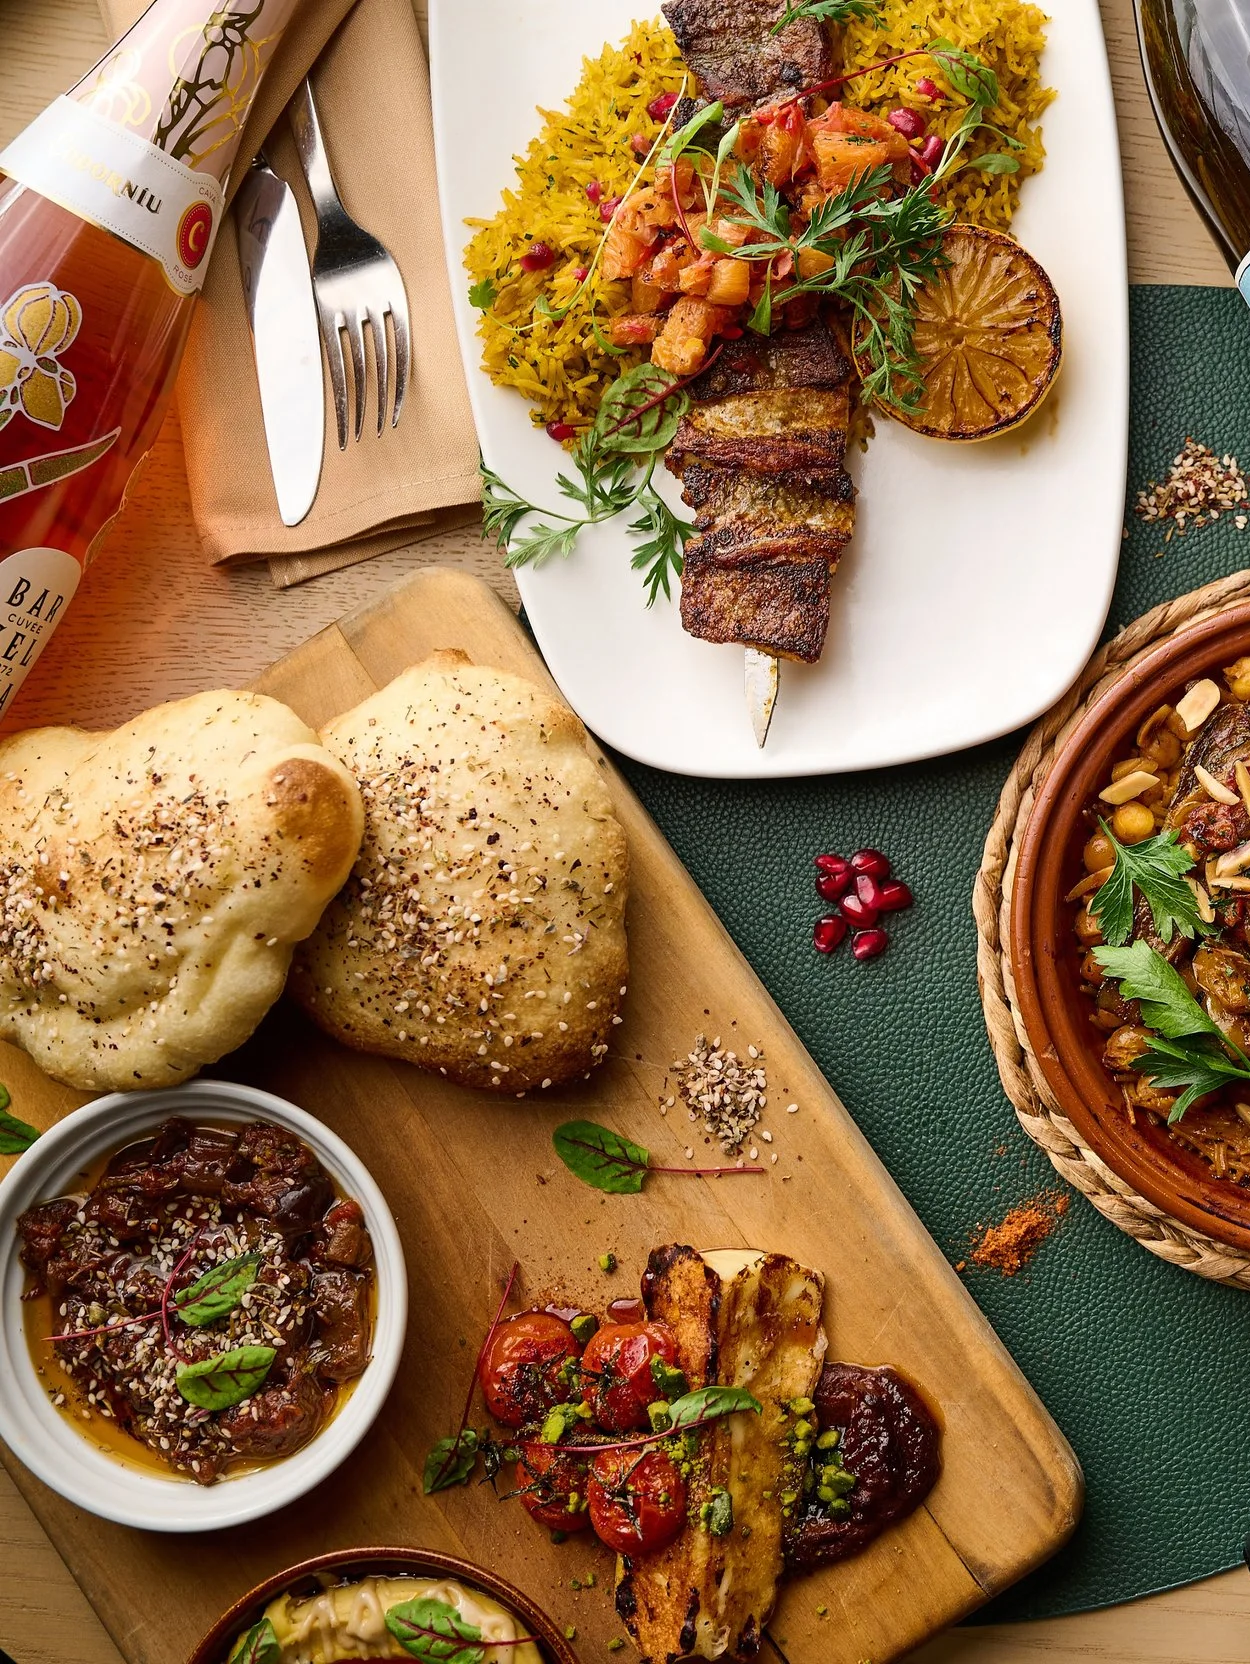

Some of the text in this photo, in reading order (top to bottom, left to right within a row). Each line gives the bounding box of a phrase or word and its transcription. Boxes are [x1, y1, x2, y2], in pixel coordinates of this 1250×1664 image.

[198, 187, 217, 204] CAVA
[188, 220, 205, 252] C
[173, 264, 193, 284] ROSÉ
[5, 576, 64, 624] BAR
[7, 613, 44, 635] CUVÉE
[0, 622, 38, 667] EL
[0, 663, 13, 677] 72
